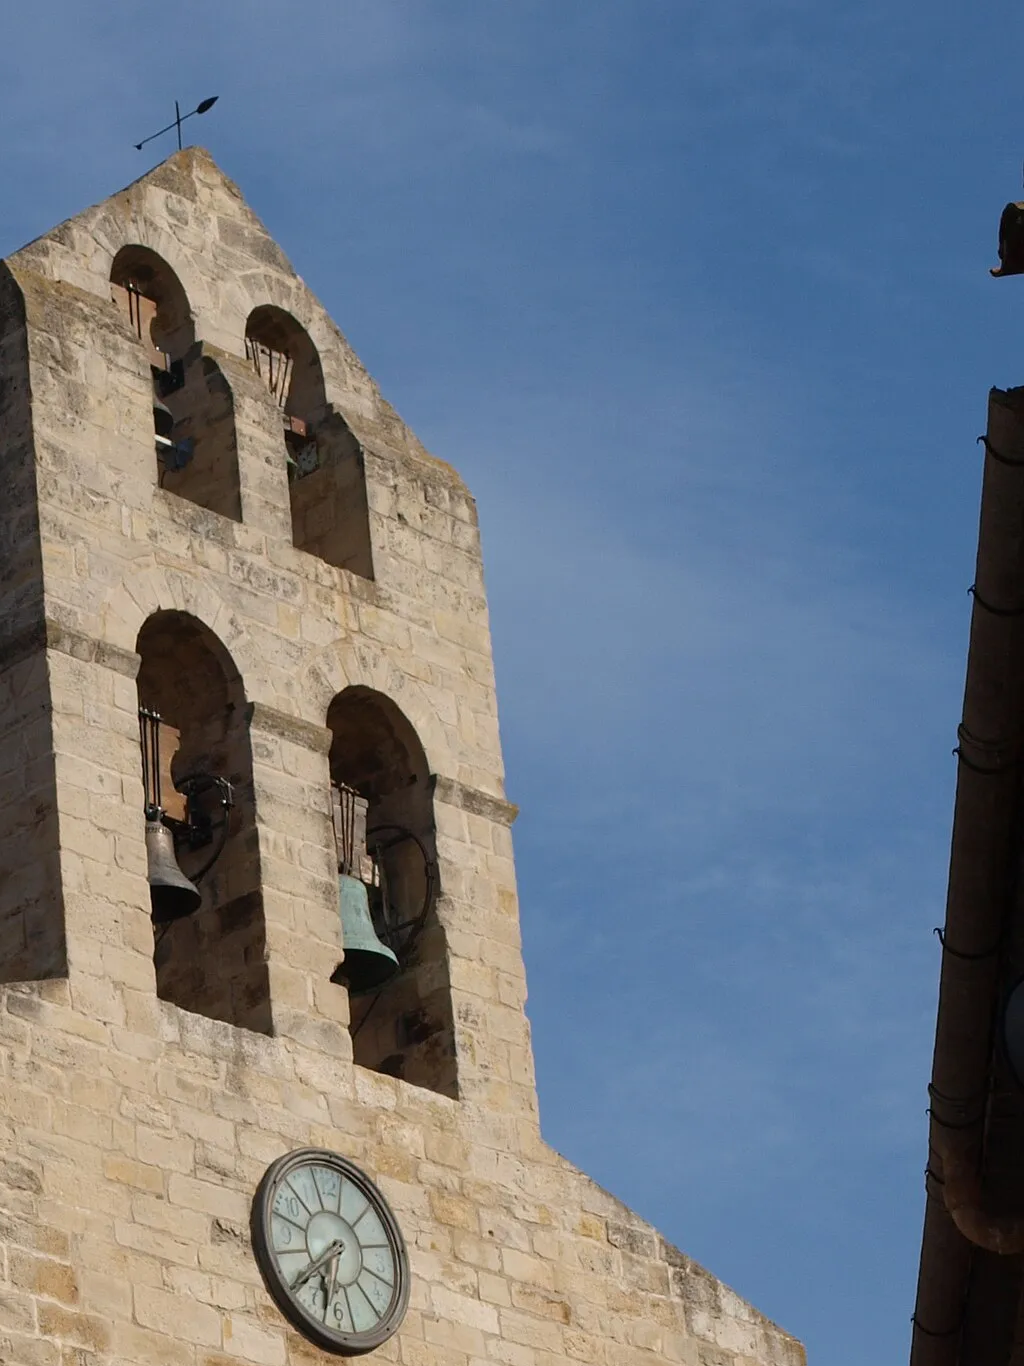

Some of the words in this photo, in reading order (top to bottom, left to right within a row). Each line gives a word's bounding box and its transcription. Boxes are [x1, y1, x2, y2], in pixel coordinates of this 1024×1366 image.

[321, 1179, 337, 1199] 12
[285, 1196, 300, 1217] 10
[281, 1225, 292, 1245] 9
[309, 1285, 321, 1306] 7
[333, 1301, 344, 1321] 6
